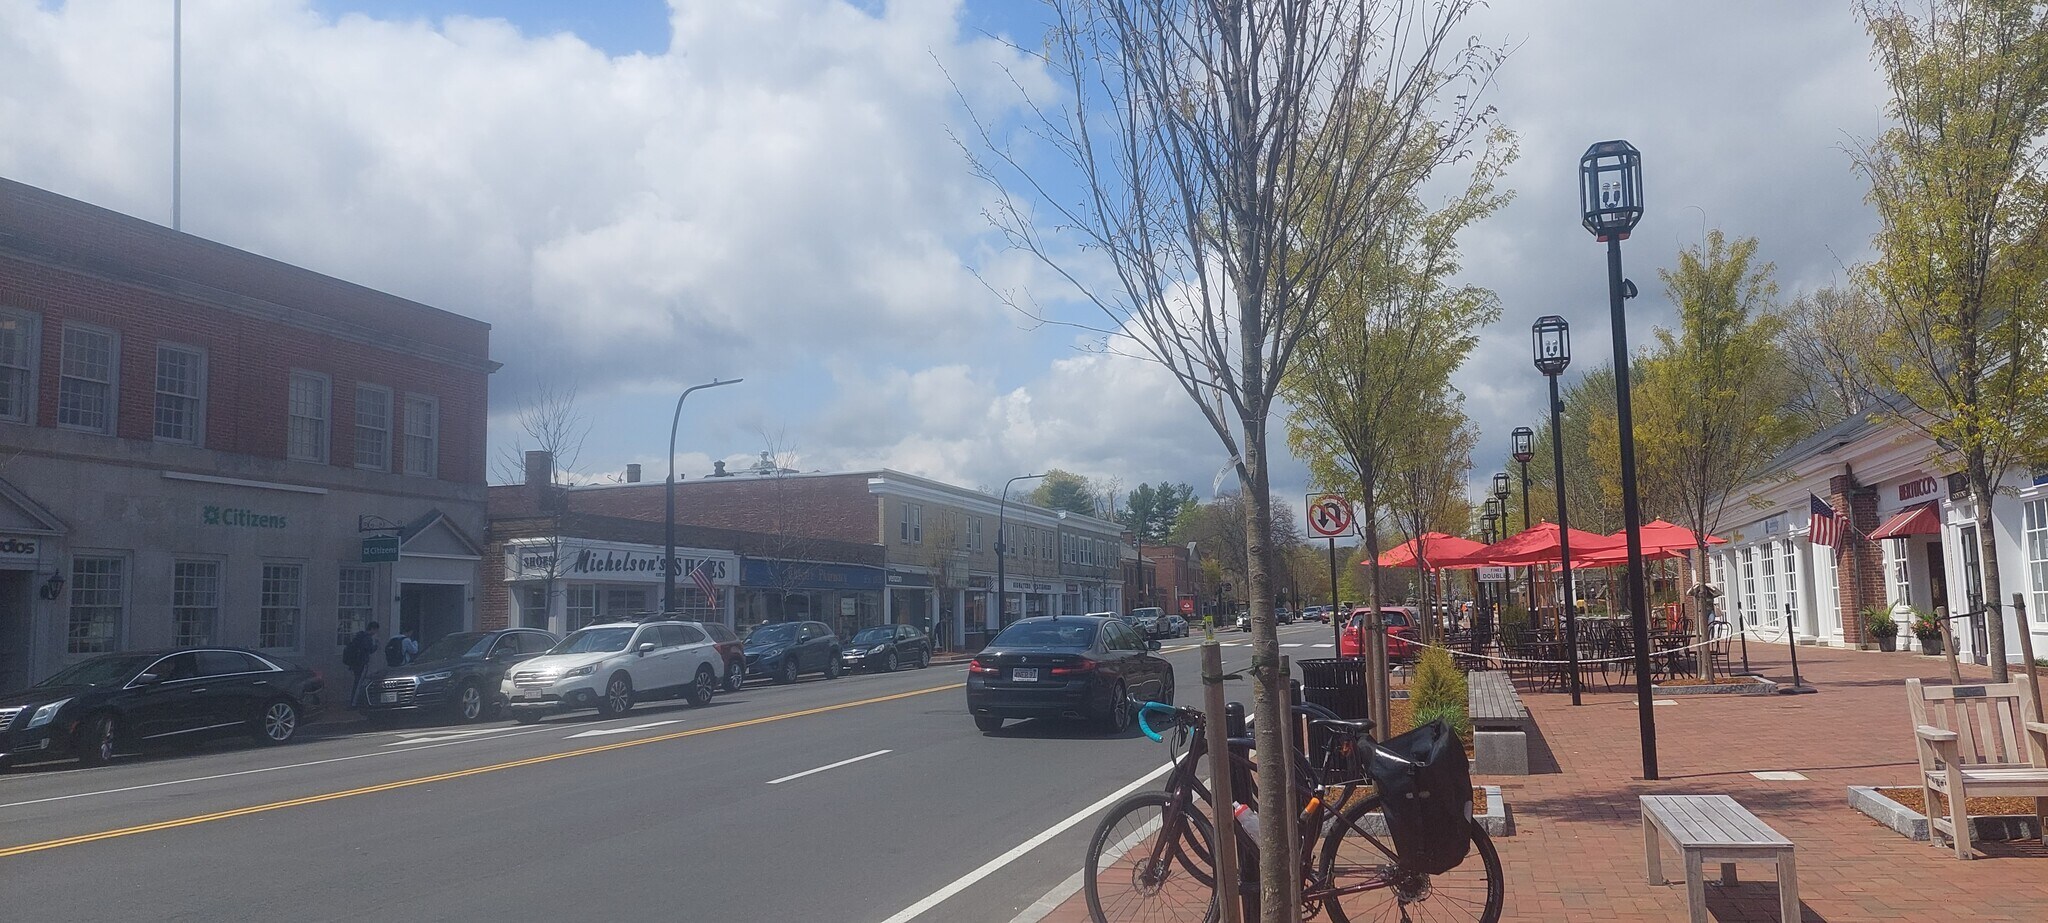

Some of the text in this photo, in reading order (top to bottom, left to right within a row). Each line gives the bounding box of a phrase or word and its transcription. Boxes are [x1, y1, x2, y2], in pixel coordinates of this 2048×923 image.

[222, 508, 287, 528] Citizens
[0, 539, 35, 554] dios
[369, 546, 397, 554] Citizens
[574, 549, 666, 573] Michelson's
